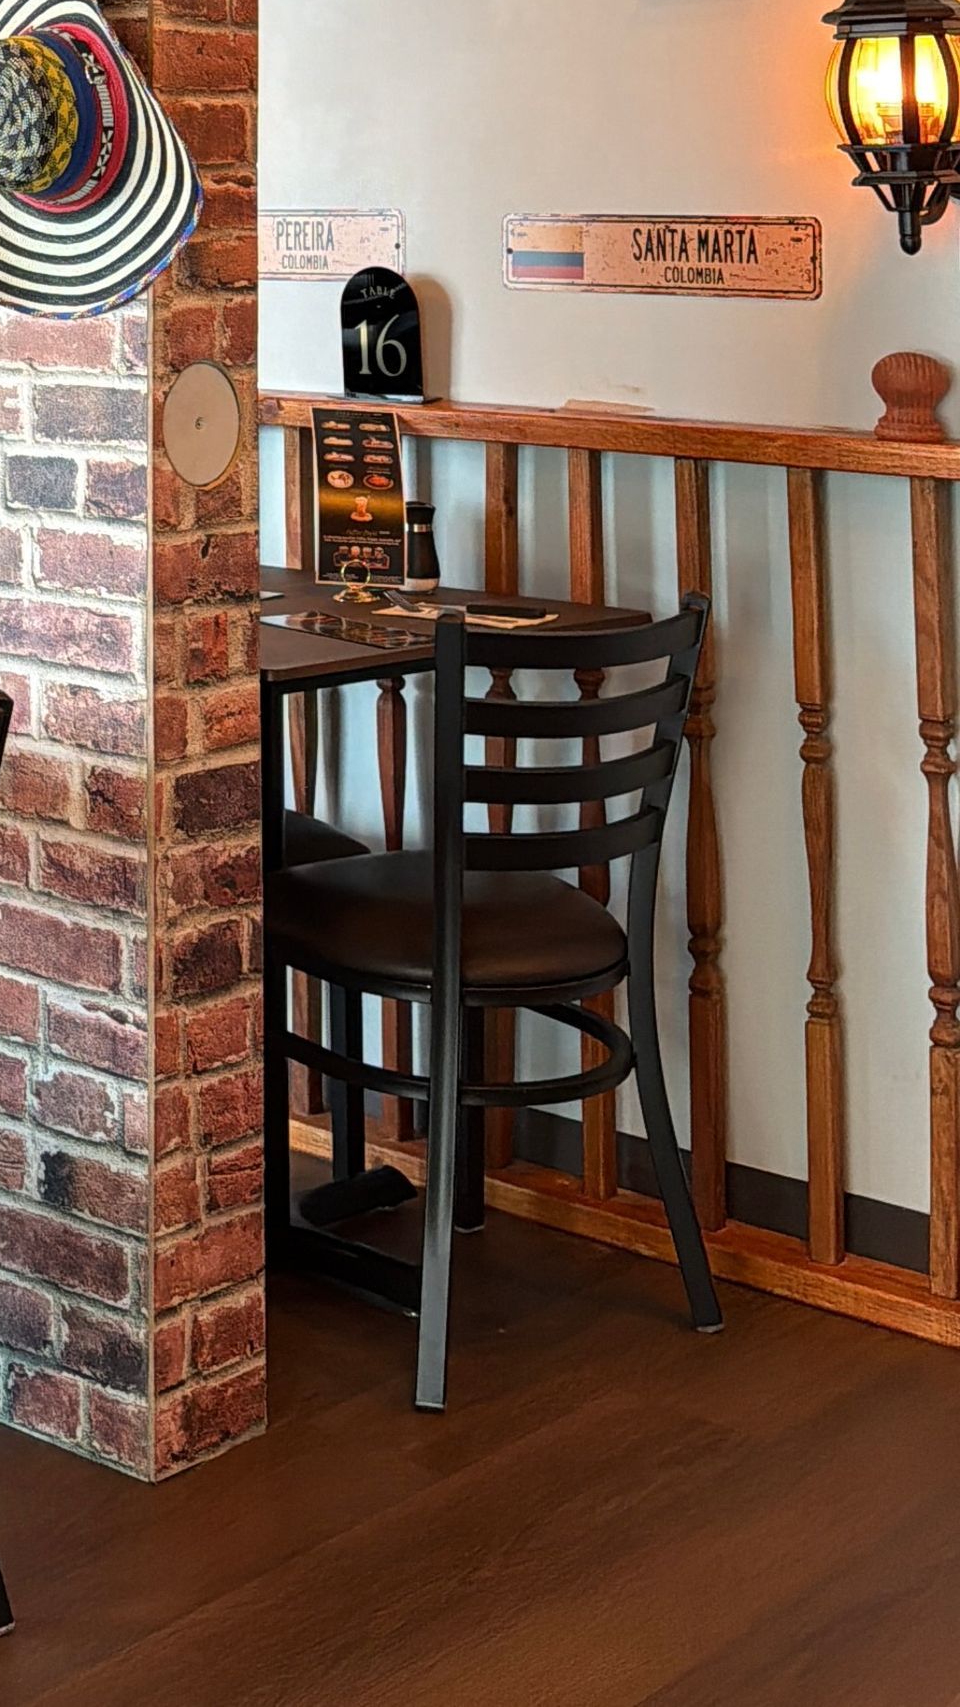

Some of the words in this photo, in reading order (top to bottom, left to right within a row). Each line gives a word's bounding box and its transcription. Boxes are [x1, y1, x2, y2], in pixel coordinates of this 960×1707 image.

[276, 220, 335, 251] PEREIRA
[632, 228, 690, 263] SANTA
[697, 228, 759, 264] MARTA
[281, 254, 329, 270] COLOMBIA
[664, 266, 725, 285] COLOMBIA
[360, 284, 396, 300] TABLE
[354, 313, 407, 377] 16
